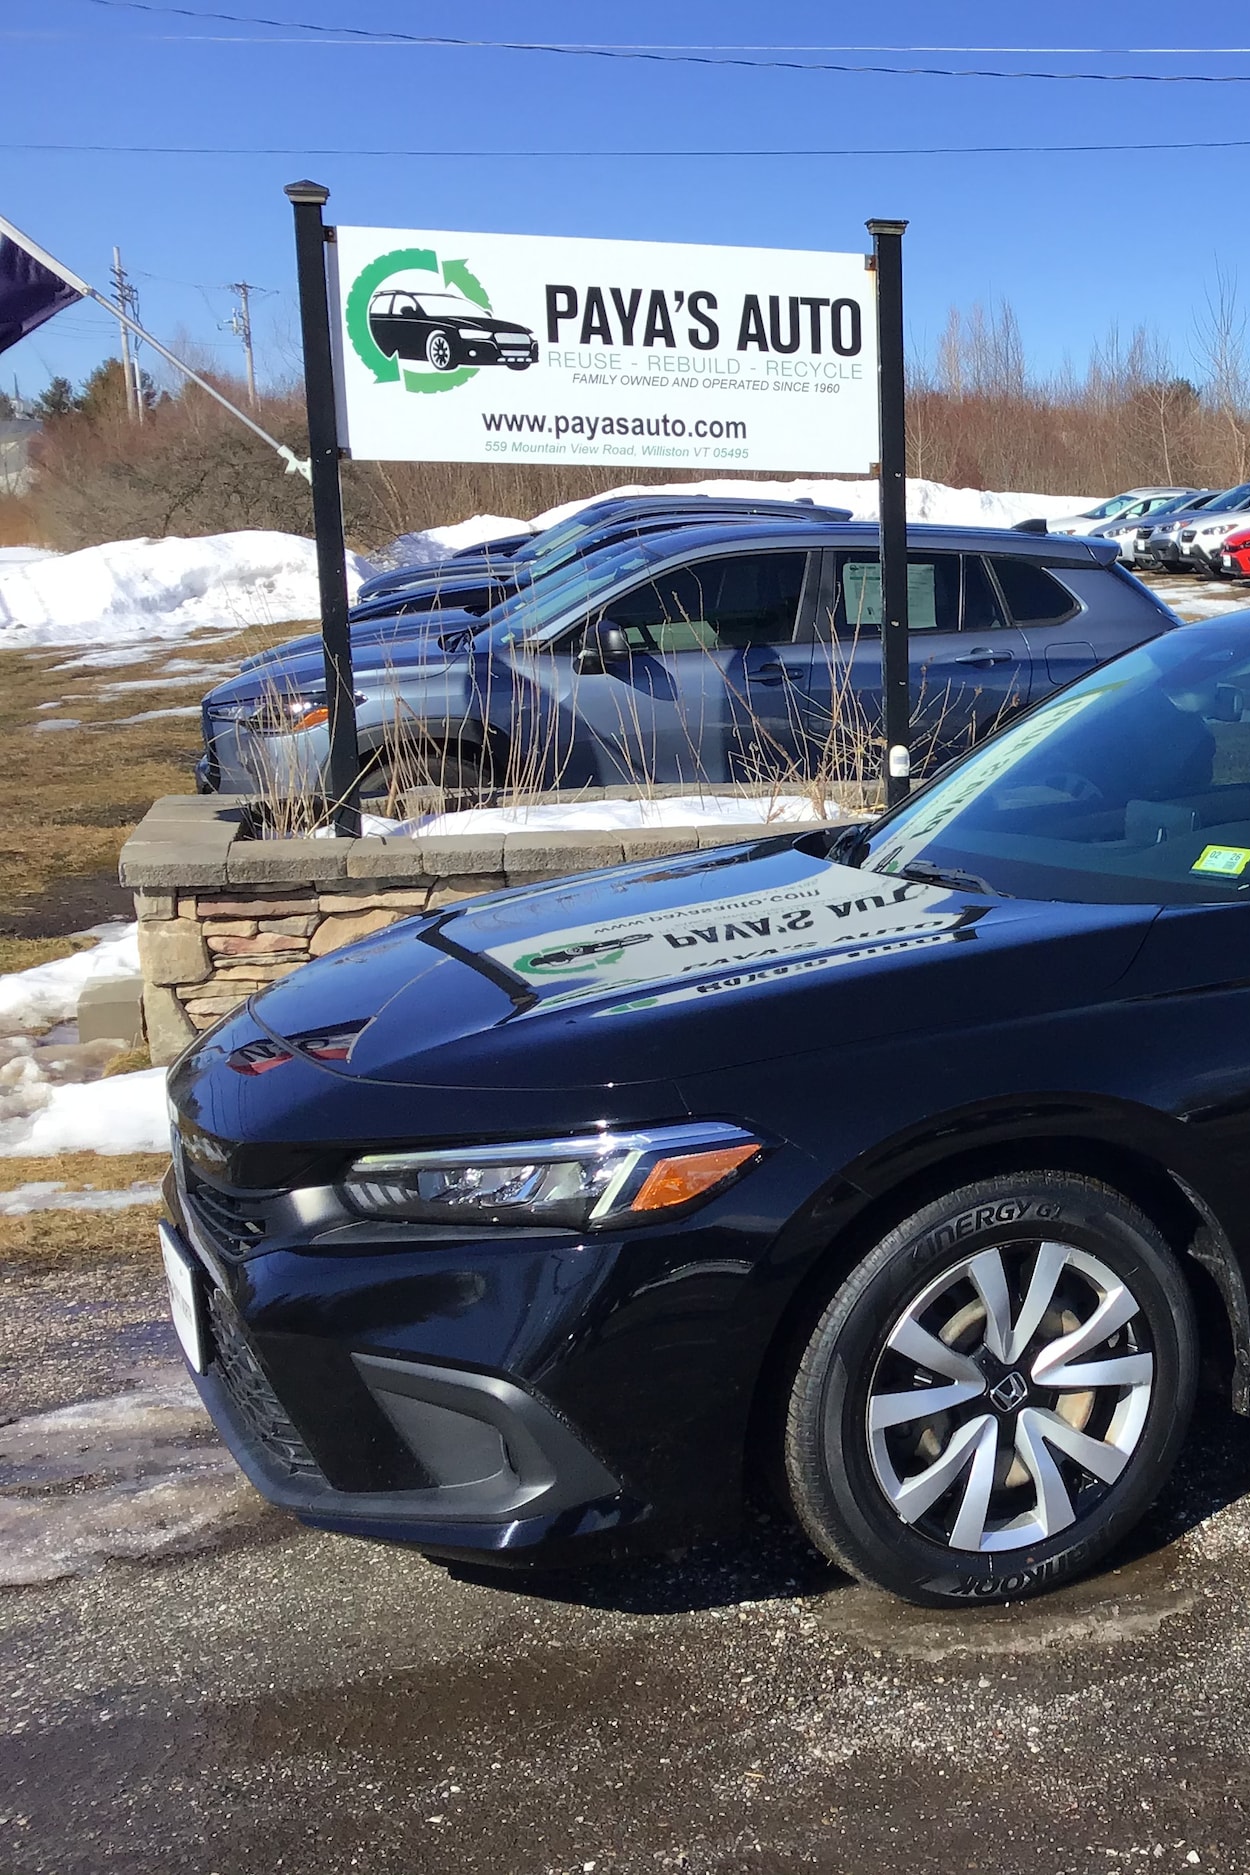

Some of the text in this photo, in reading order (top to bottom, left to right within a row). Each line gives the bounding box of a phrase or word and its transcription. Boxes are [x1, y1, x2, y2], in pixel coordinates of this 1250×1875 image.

[545, 283, 863, 357] PAYA'S AUTO
[548, 351, 622, 370] REUSE
[647, 354, 741, 374] REBUILD
[765, 360, 863, 380] RECYCLE
[572, 372, 841, 394] FAMILY OWNED AND OPERATED SINCE 1960
[481, 412, 747, 441] www.payasauto.com
[484, 440, 749, 459] 559 Mountain View Road, Williston VT 05495
